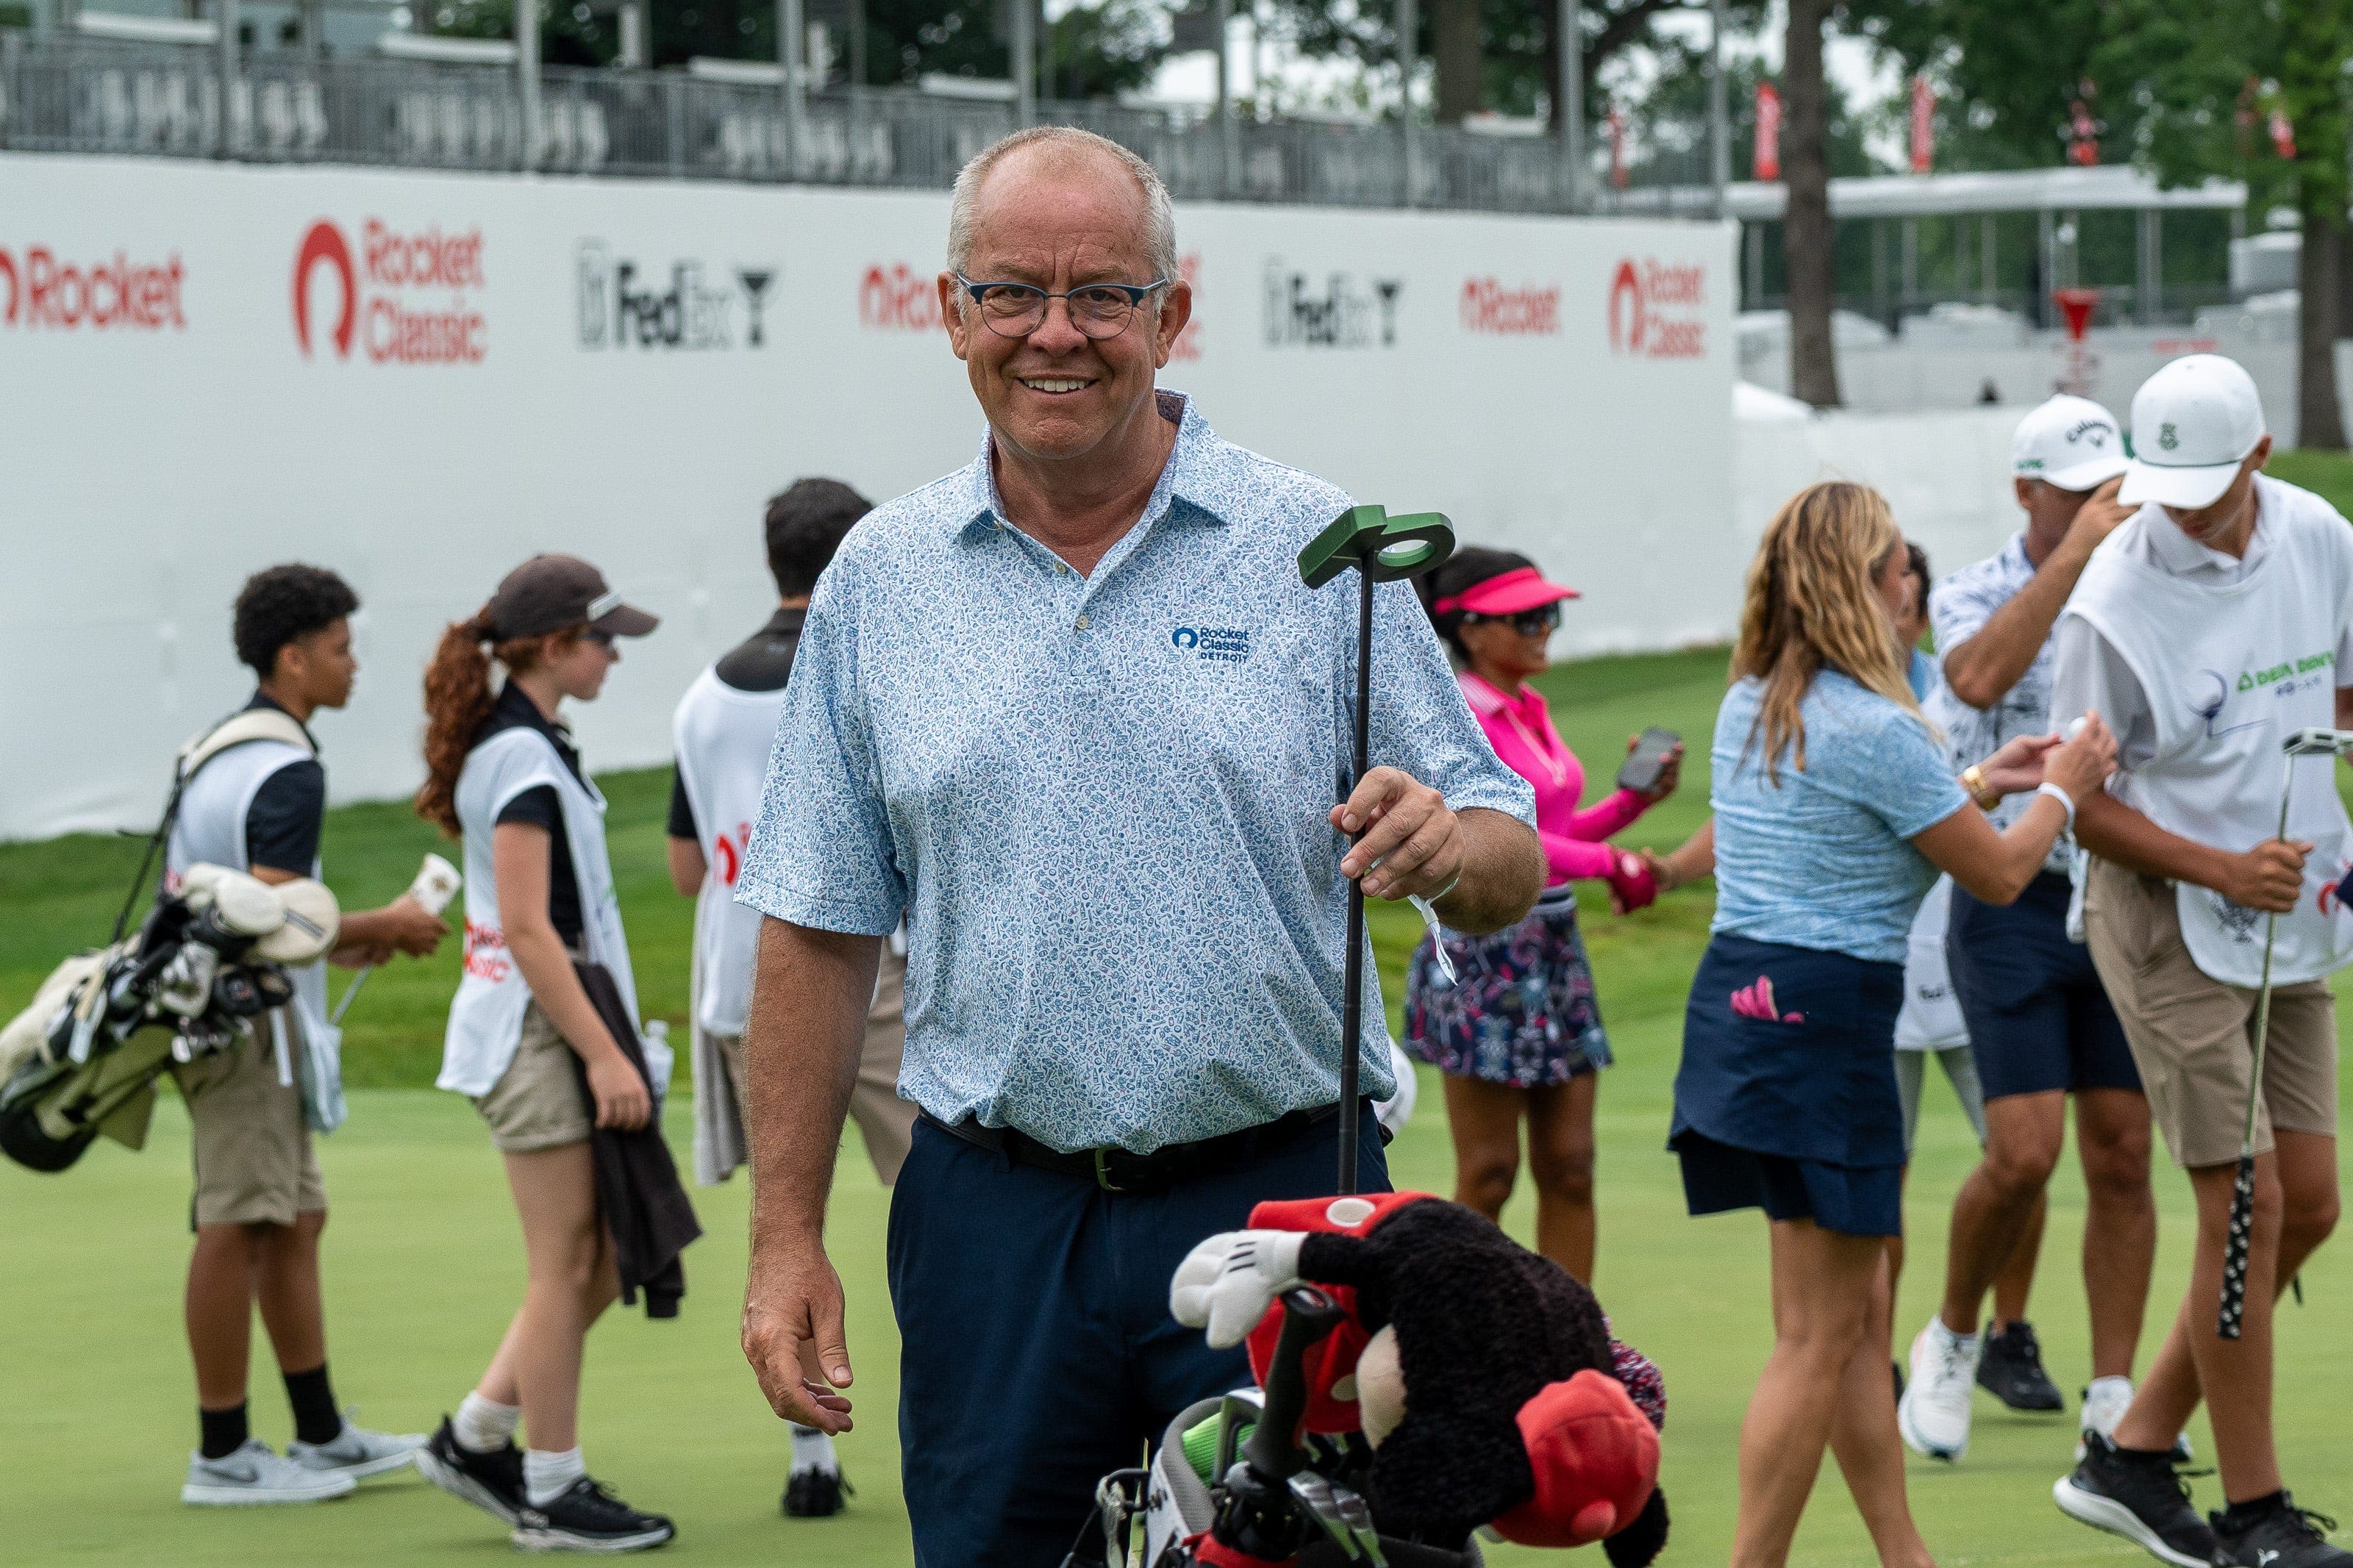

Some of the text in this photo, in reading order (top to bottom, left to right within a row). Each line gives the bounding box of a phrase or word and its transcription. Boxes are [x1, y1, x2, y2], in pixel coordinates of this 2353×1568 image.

[25, 243, 188, 331] Rocket
[365, 216, 485, 288] Rocket
[365, 295, 488, 365] Classic
[615, 259, 735, 351] FedEx
[1200, 626, 1249, 641] Rocket
[1200, 638, 1249, 653] Classic
[1201, 652, 1247, 663] DETROIT
